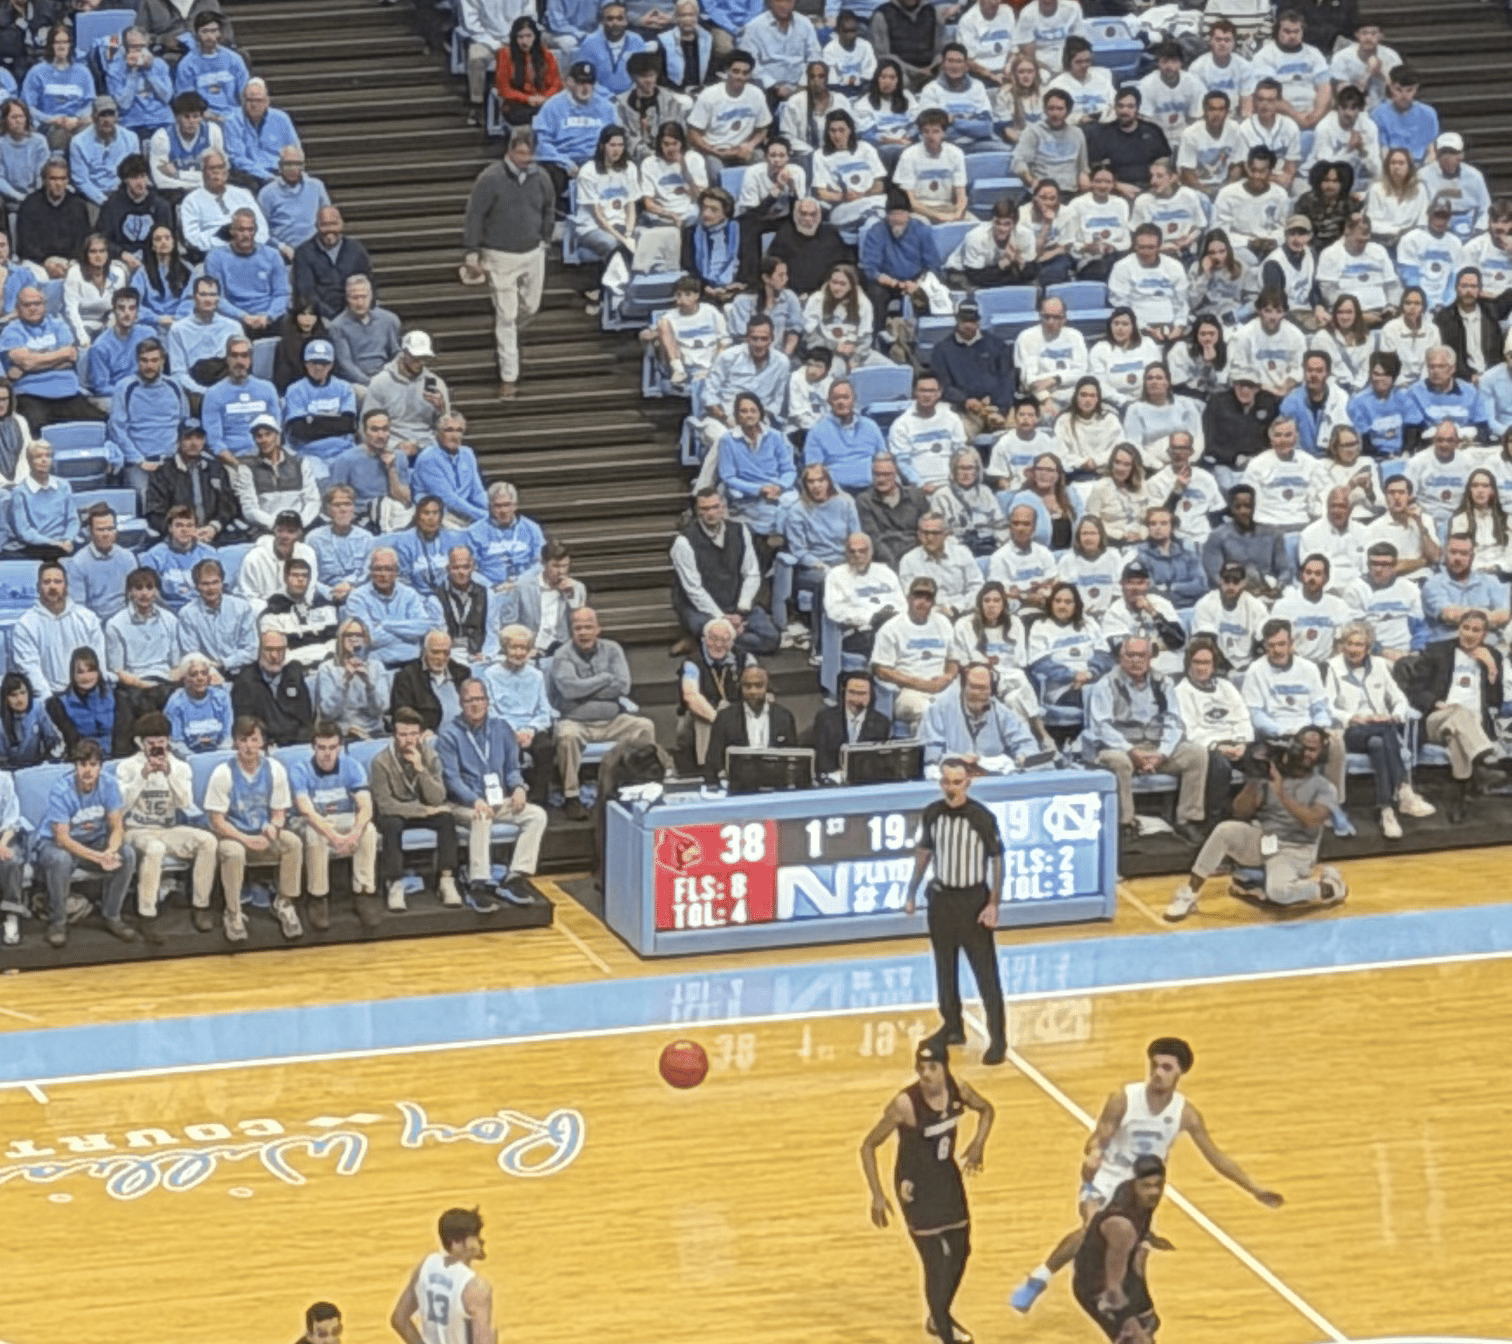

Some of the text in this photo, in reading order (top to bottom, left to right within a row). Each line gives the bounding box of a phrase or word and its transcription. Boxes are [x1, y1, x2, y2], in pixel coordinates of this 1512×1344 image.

[720, 823, 766, 864] 38
[1004, 845, 1075, 874] FLS: 2
[674, 872, 748, 903] FLS: 8
[1002, 871, 1075, 900] TOL: 3
[672, 899, 748, 929] TOL: 4
[4, 1118, 285, 1157] COURT
[426, 1289, 450, 1326] 13
